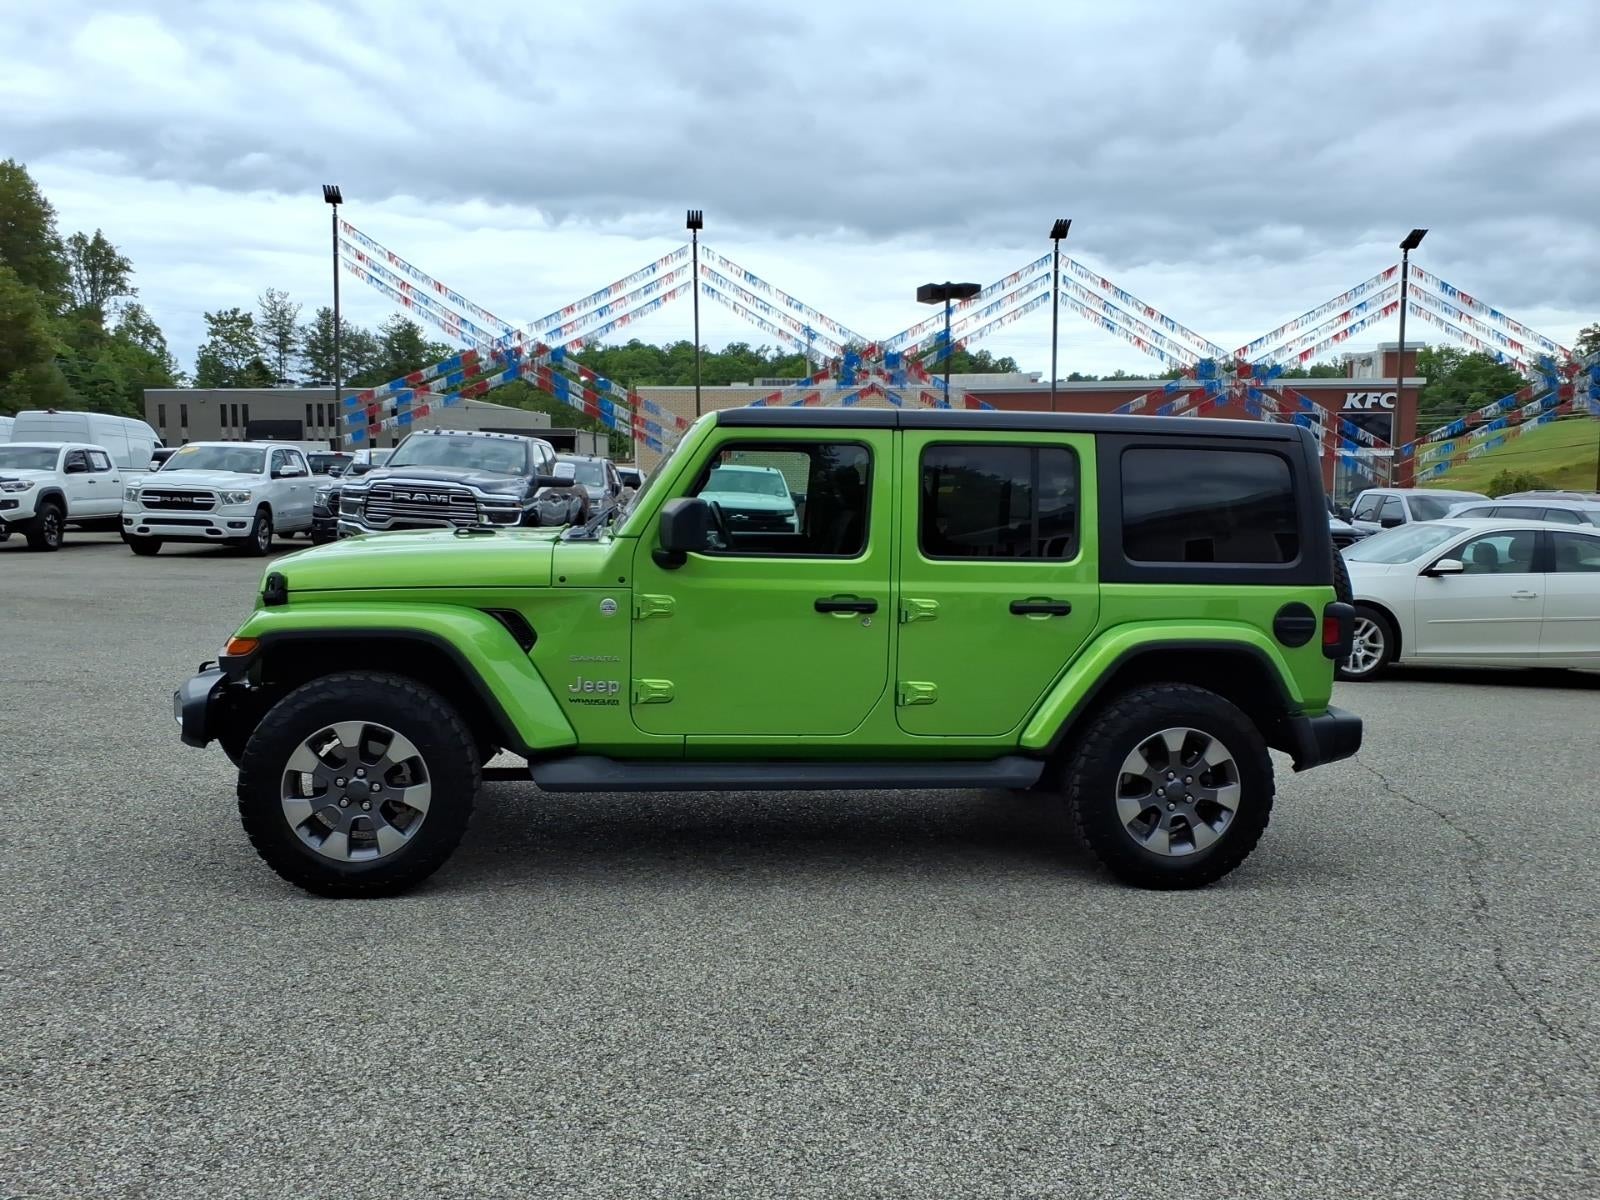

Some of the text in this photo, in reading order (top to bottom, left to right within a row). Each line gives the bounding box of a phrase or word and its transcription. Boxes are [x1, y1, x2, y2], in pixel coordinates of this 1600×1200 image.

[1342, 392, 1397, 409] KFC
[393, 491, 448, 503] RAM
[568, 676, 620, 696] Jeep
[568, 698, 620, 706] WRANGLER
